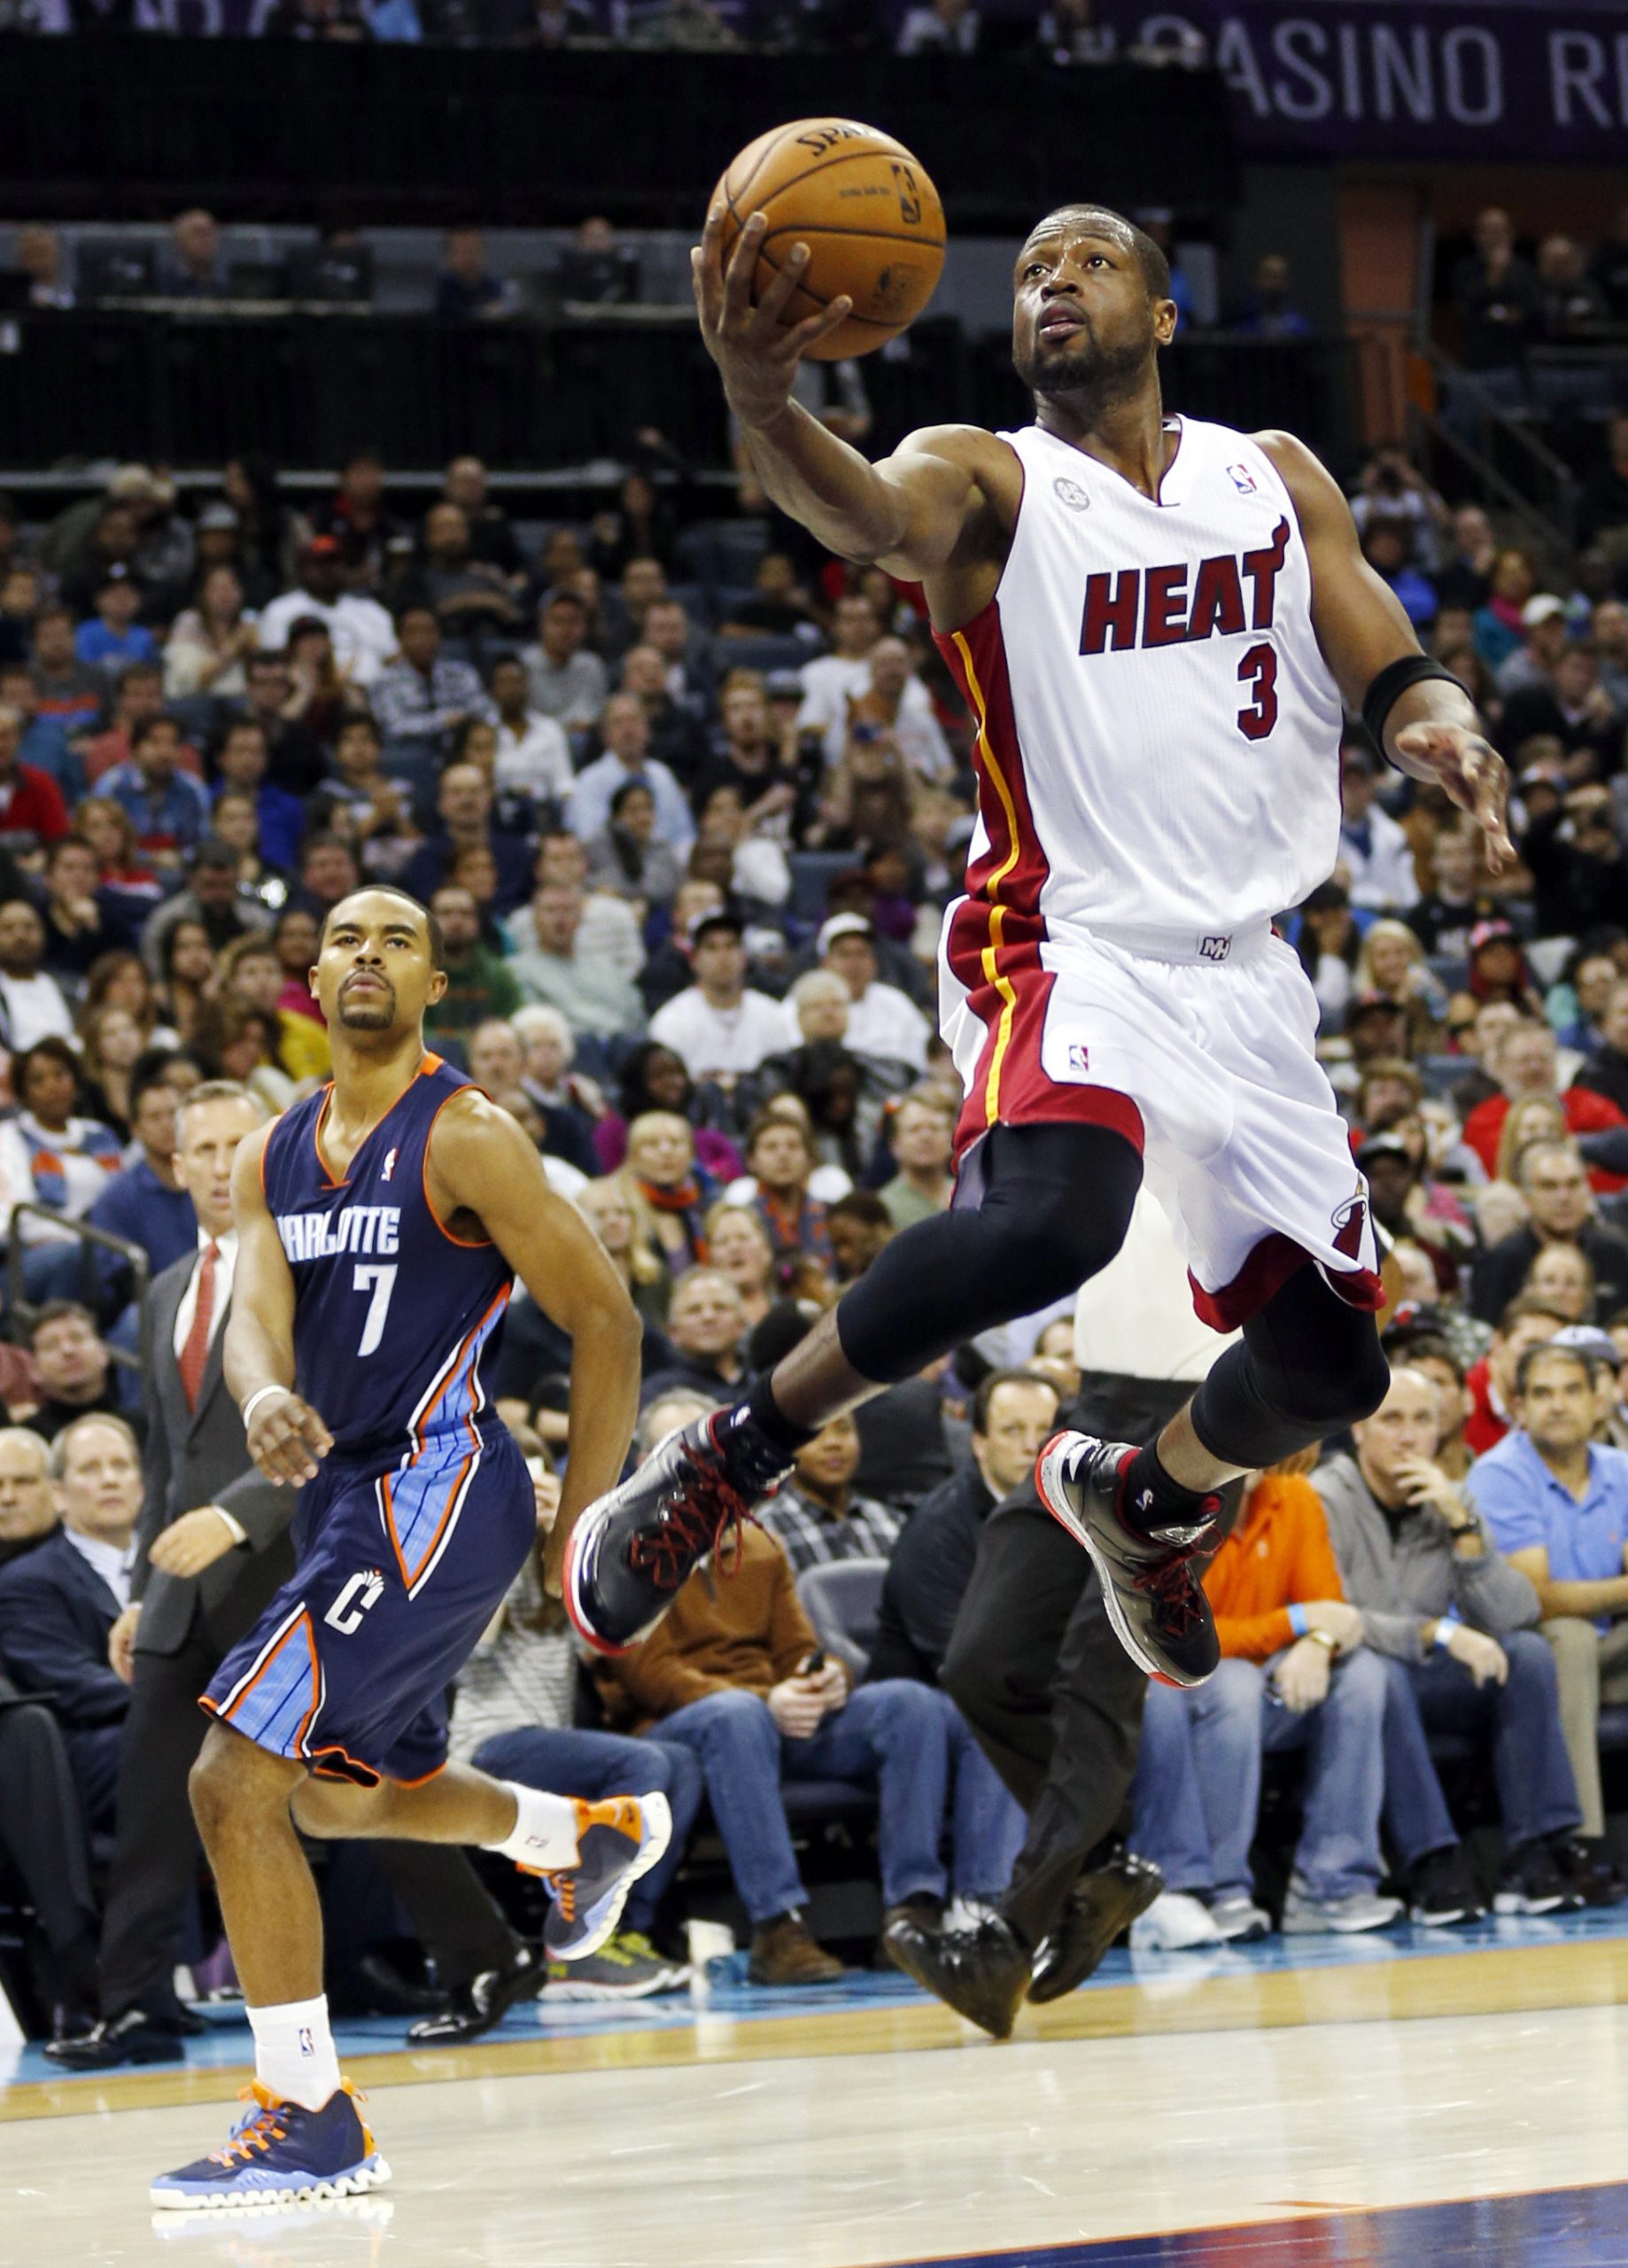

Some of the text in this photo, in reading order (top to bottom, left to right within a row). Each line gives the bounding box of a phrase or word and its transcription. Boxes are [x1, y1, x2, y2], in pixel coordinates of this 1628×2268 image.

[1548, 31, 1628, 128] R
[1079, 515, 1291, 656] HEAT
[1237, 642, 1278, 742] 3
[353, 1264, 398, 1357] 7
